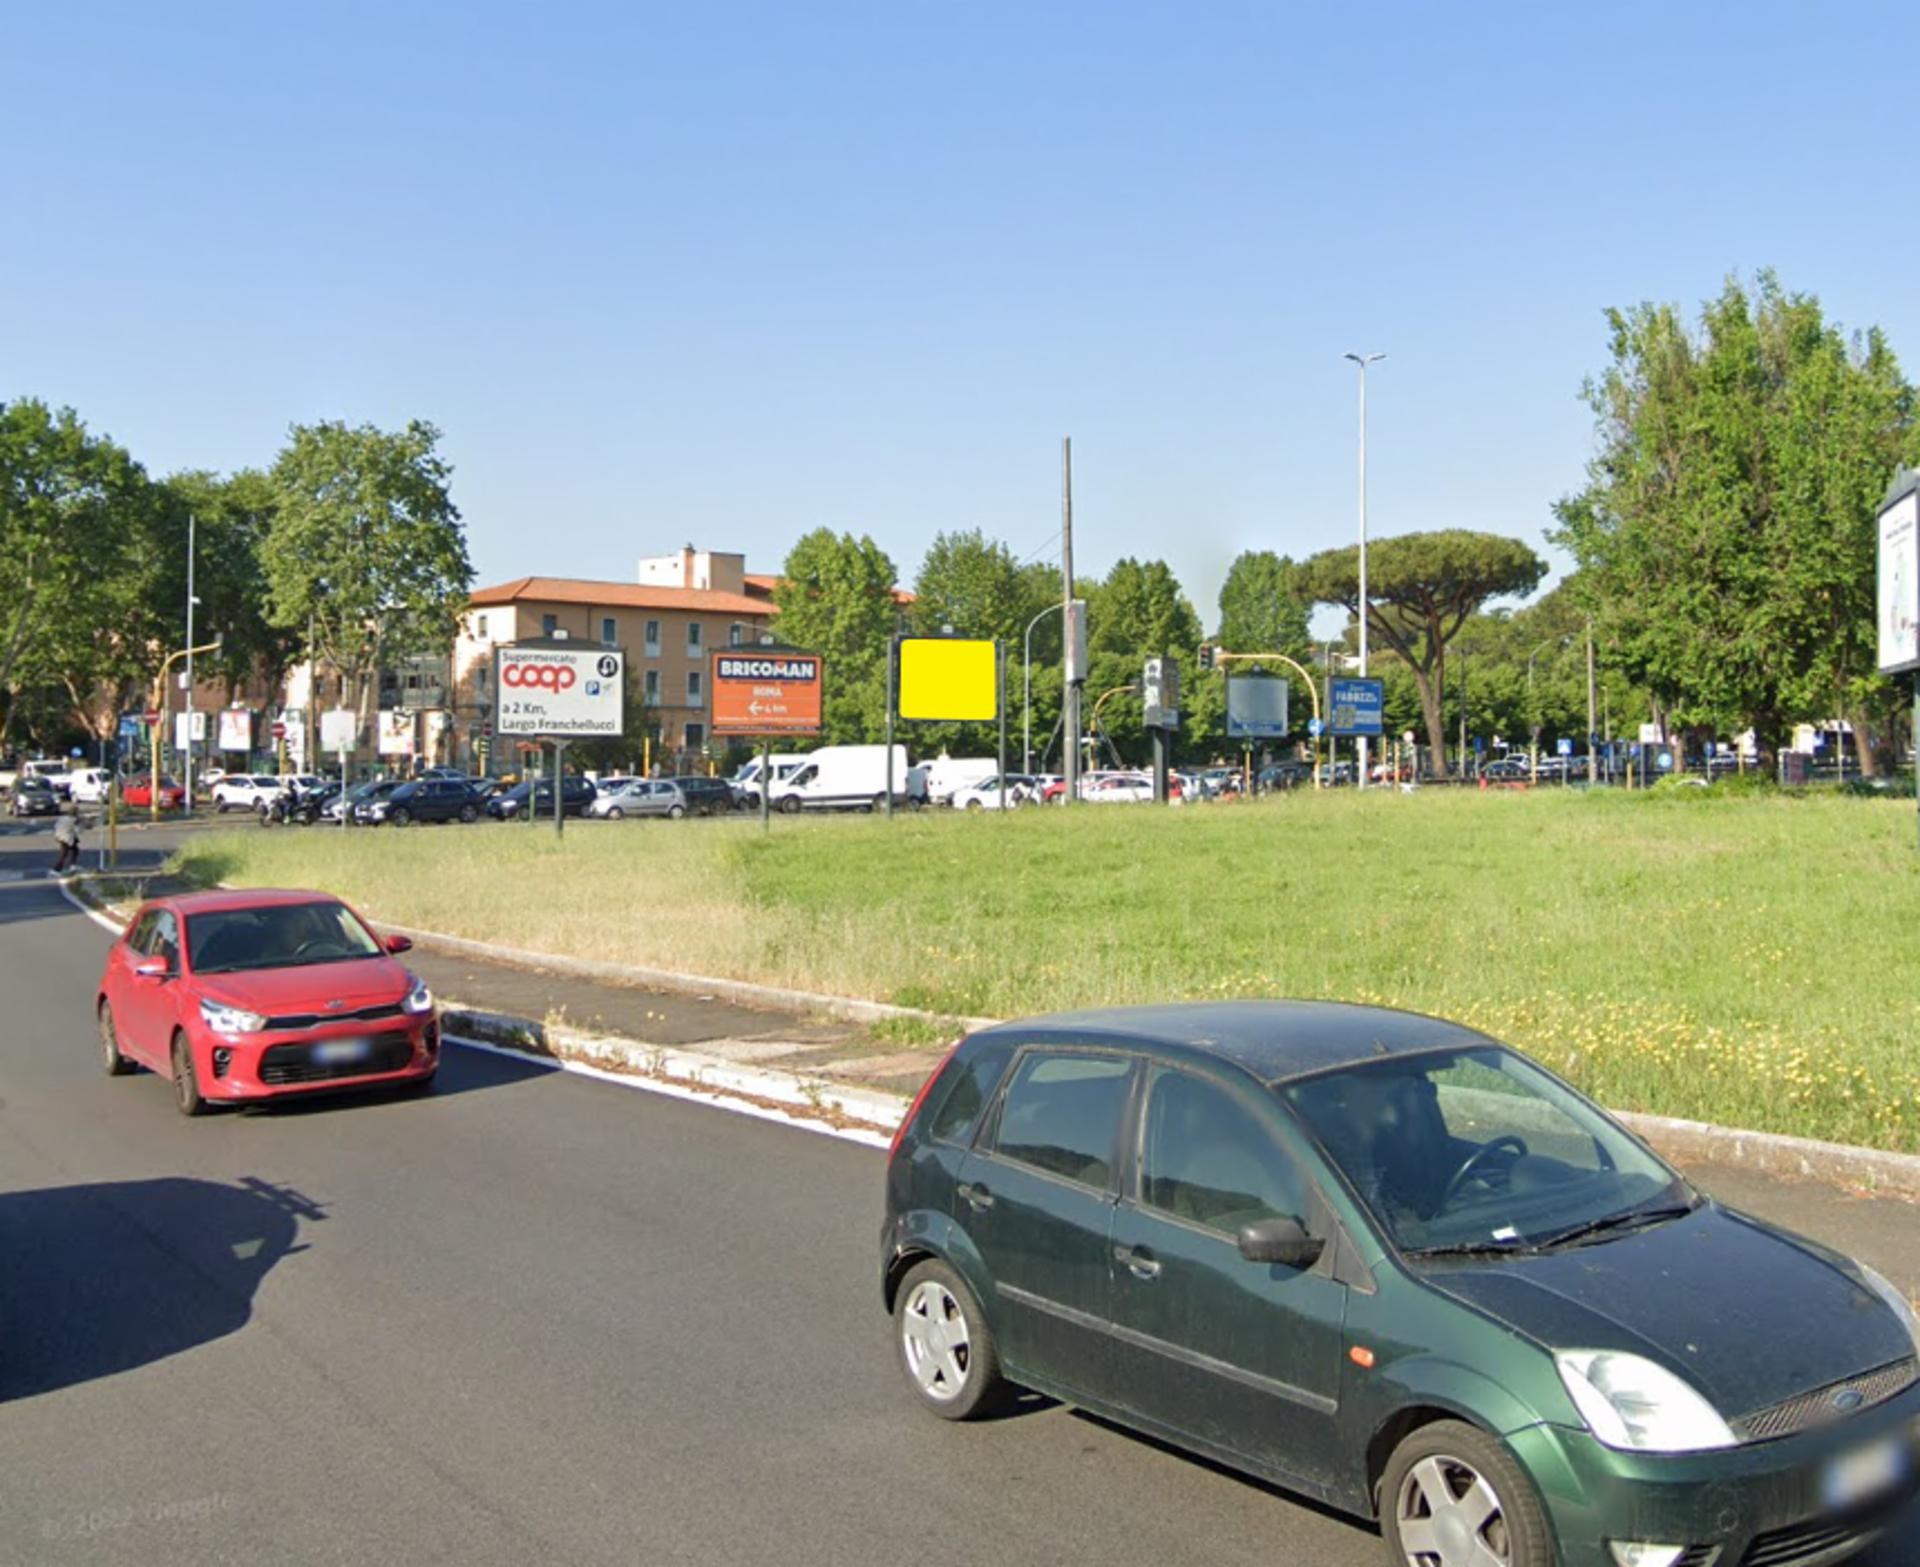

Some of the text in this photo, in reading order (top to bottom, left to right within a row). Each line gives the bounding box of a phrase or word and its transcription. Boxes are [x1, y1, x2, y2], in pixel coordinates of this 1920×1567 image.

[502, 652, 577, 663] Supermercato
[721, 661, 814, 677] BRICOMAN
[502, 663, 576, 693] coop
[503, 704, 510, 713] a
[512, 702, 520, 713] 2
[502, 718, 615, 730] Largo Franchellucci
